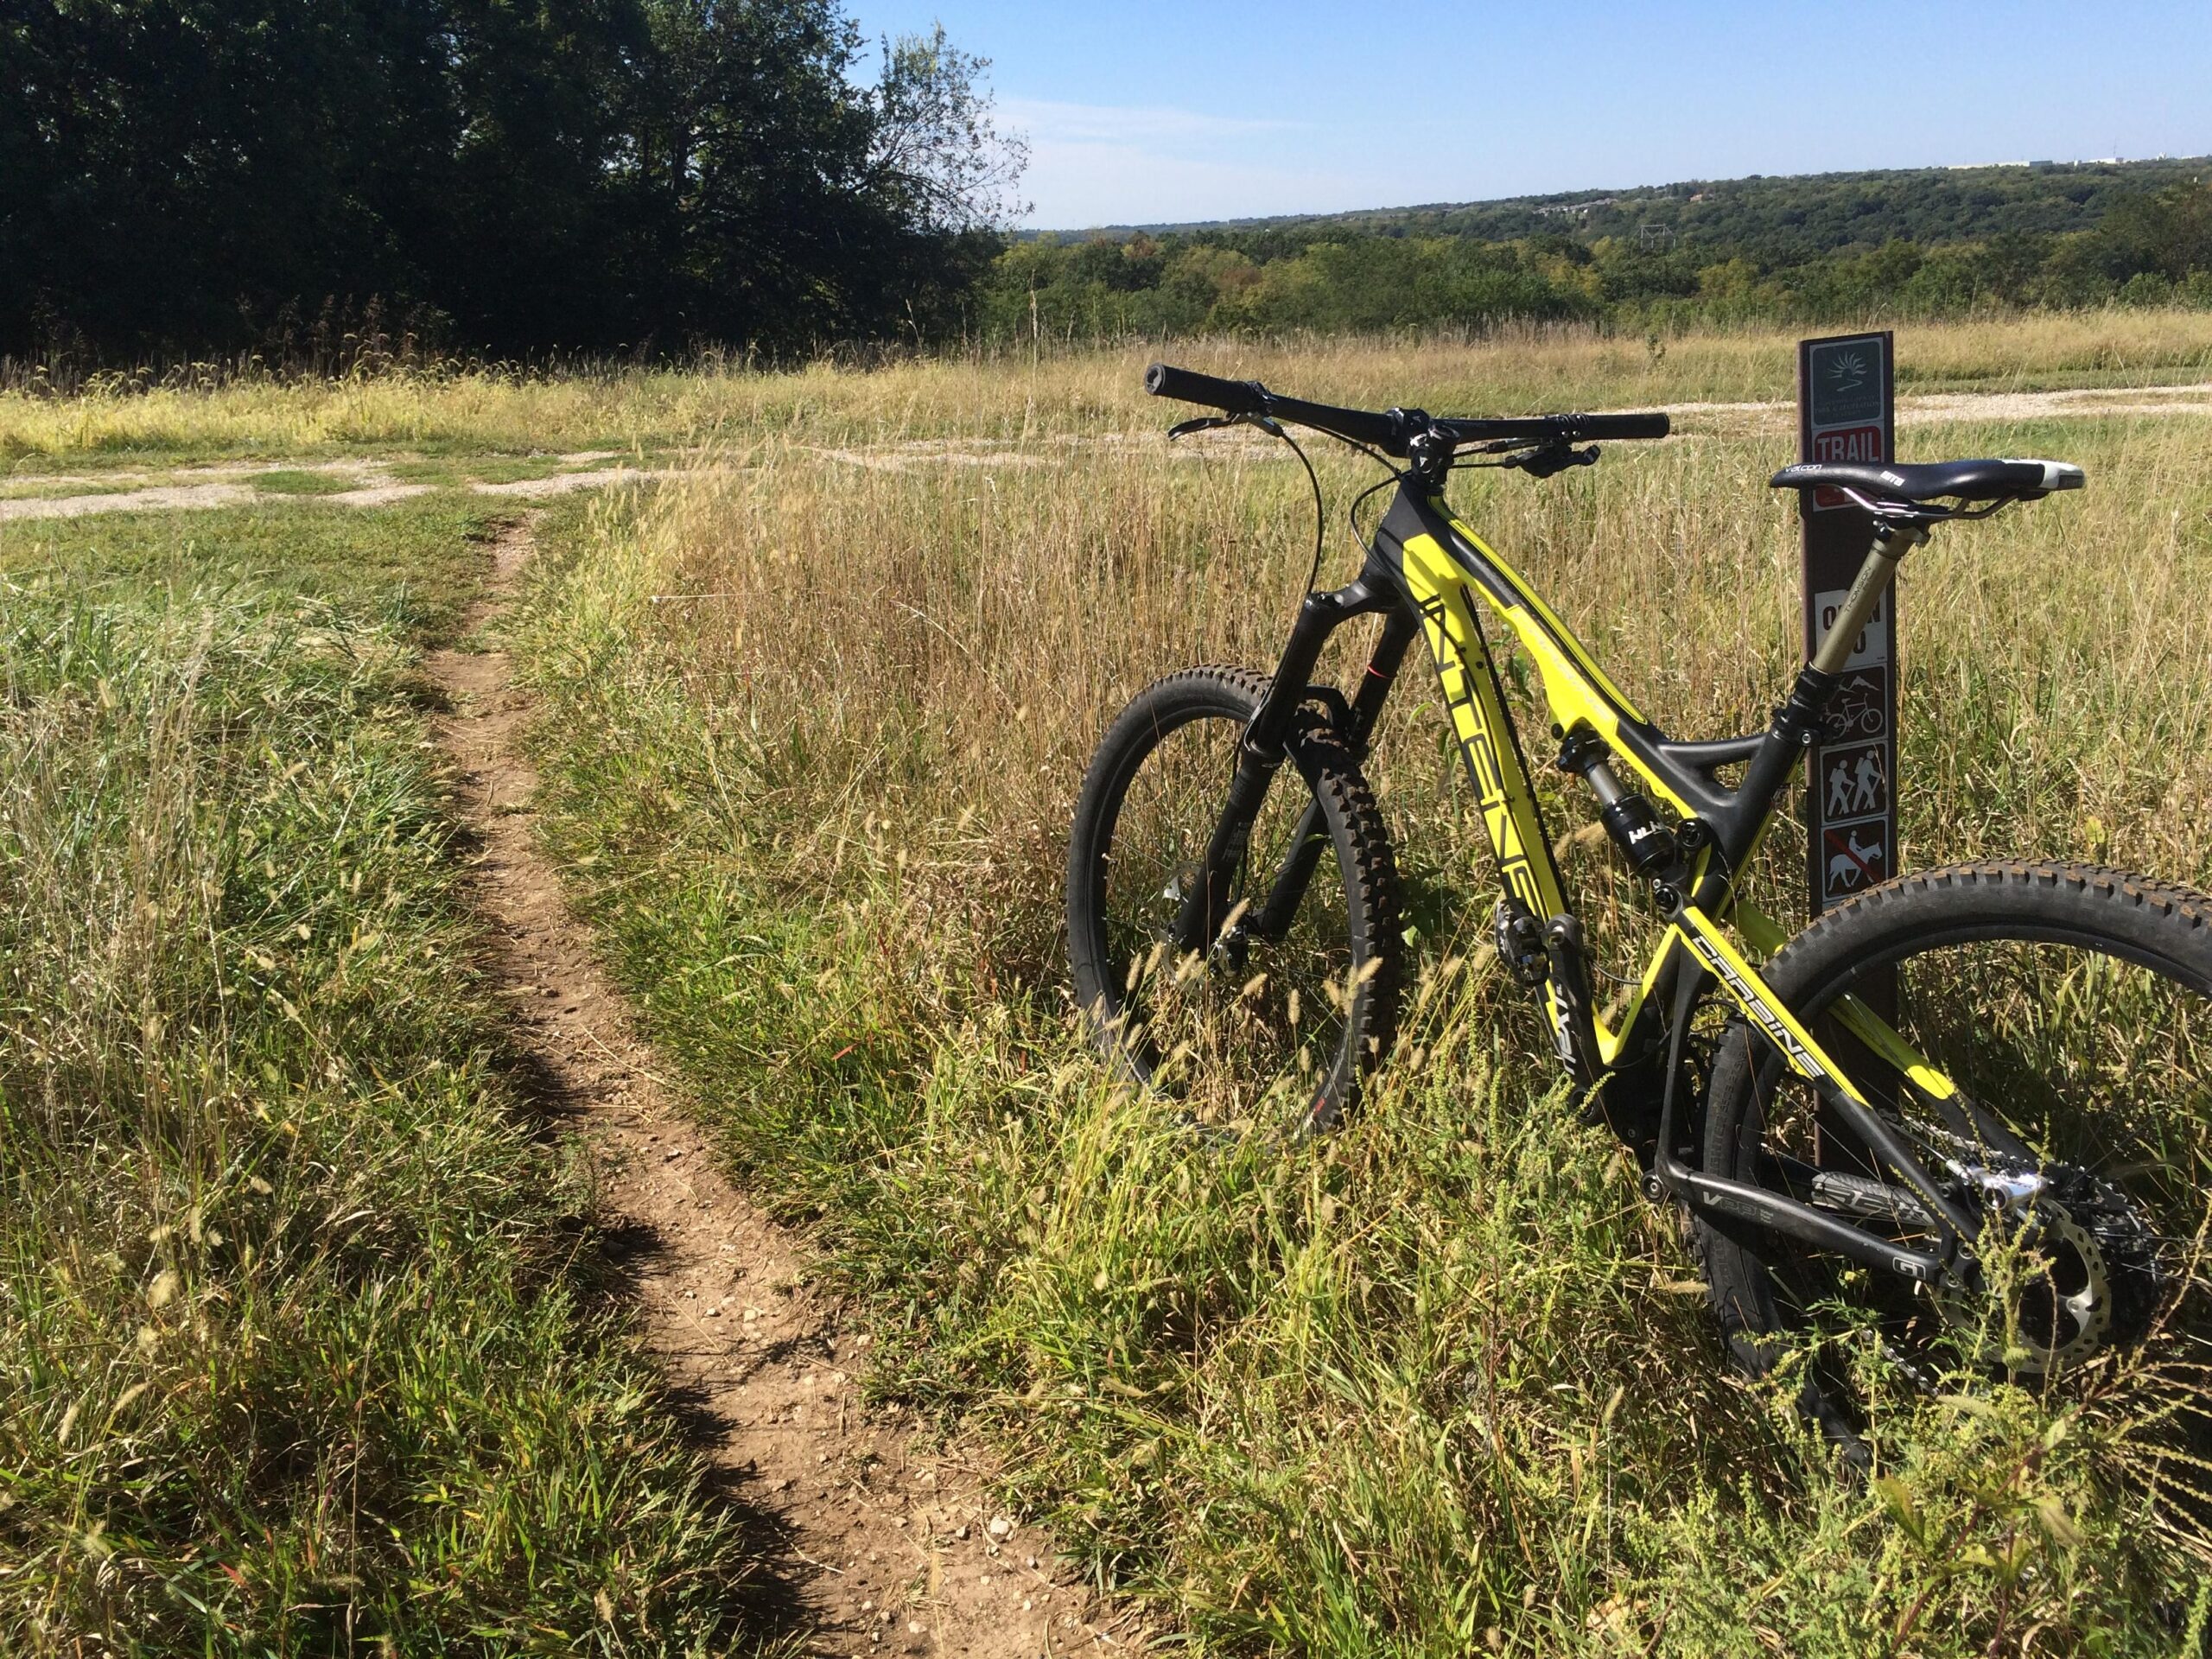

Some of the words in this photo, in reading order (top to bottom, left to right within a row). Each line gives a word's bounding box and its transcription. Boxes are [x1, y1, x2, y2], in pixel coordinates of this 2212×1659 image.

[1817, 432, 1878, 462] TRAIL
[1845, 566, 1871, 613] THOMSON
[1823, 600, 1880, 631] ON
[1419, 592, 1547, 929] INTENS
